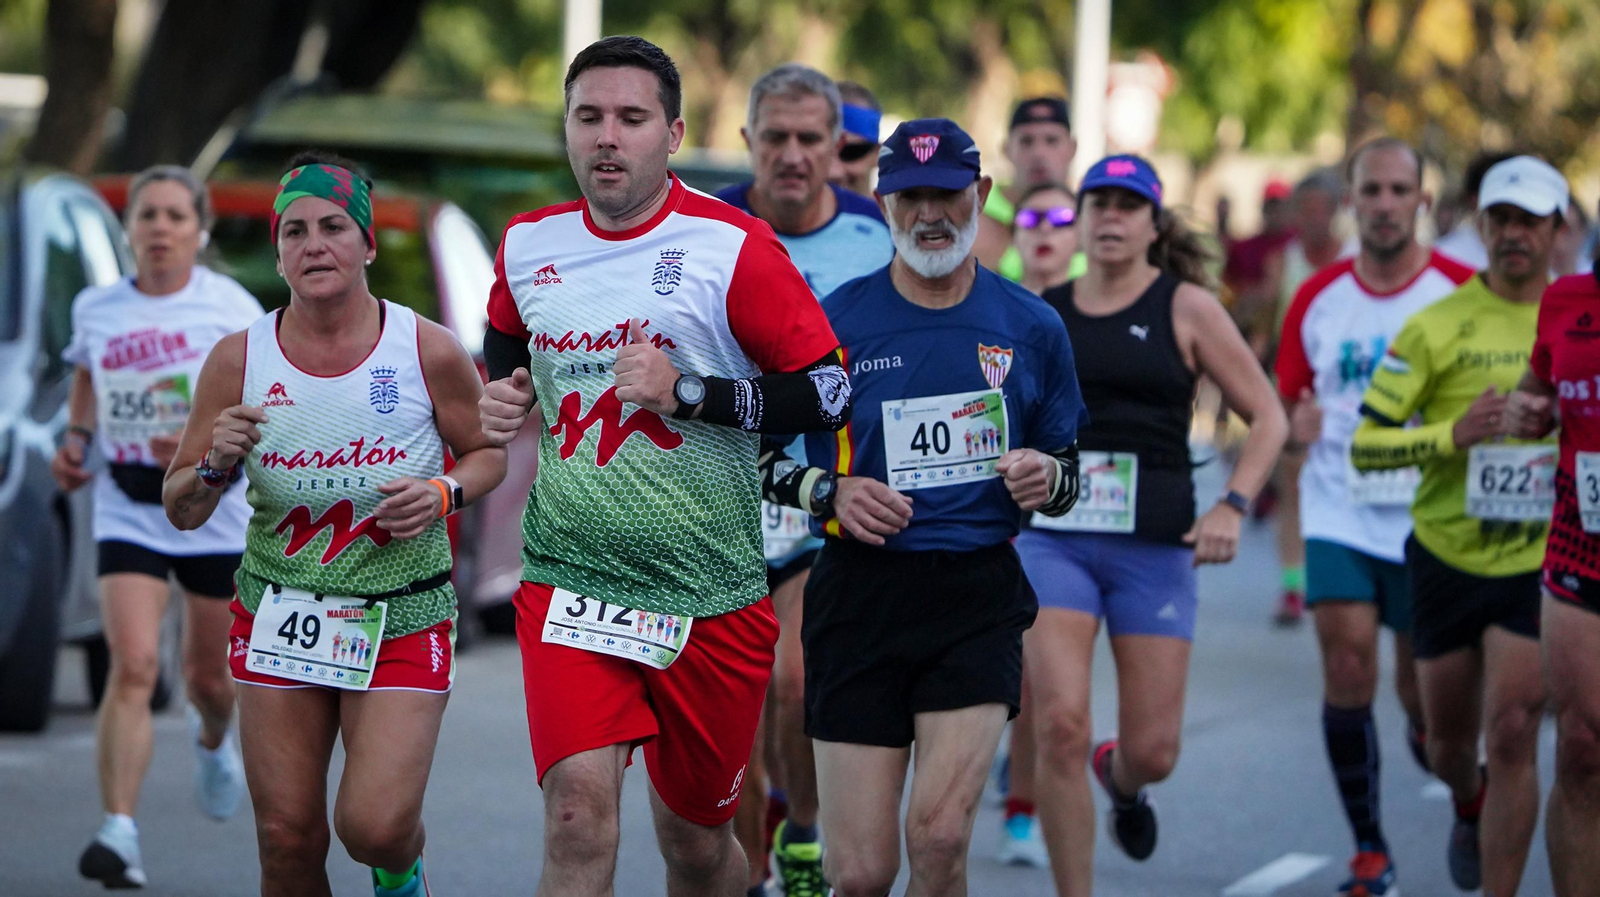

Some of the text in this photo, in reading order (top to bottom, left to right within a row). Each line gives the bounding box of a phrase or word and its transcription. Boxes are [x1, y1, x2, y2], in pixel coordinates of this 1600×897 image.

[570, 362, 614, 375] JER
[109, 390, 155, 419] 256
[261, 399, 296, 407] austral
[261, 435, 407, 470] maratón
[910, 420, 951, 456] 40
[296, 477, 366, 490] JEREZ
[1480, 464, 1532, 494] 622
[326, 609, 364, 618] MARATÓN
[277, 611, 321, 649] 49
